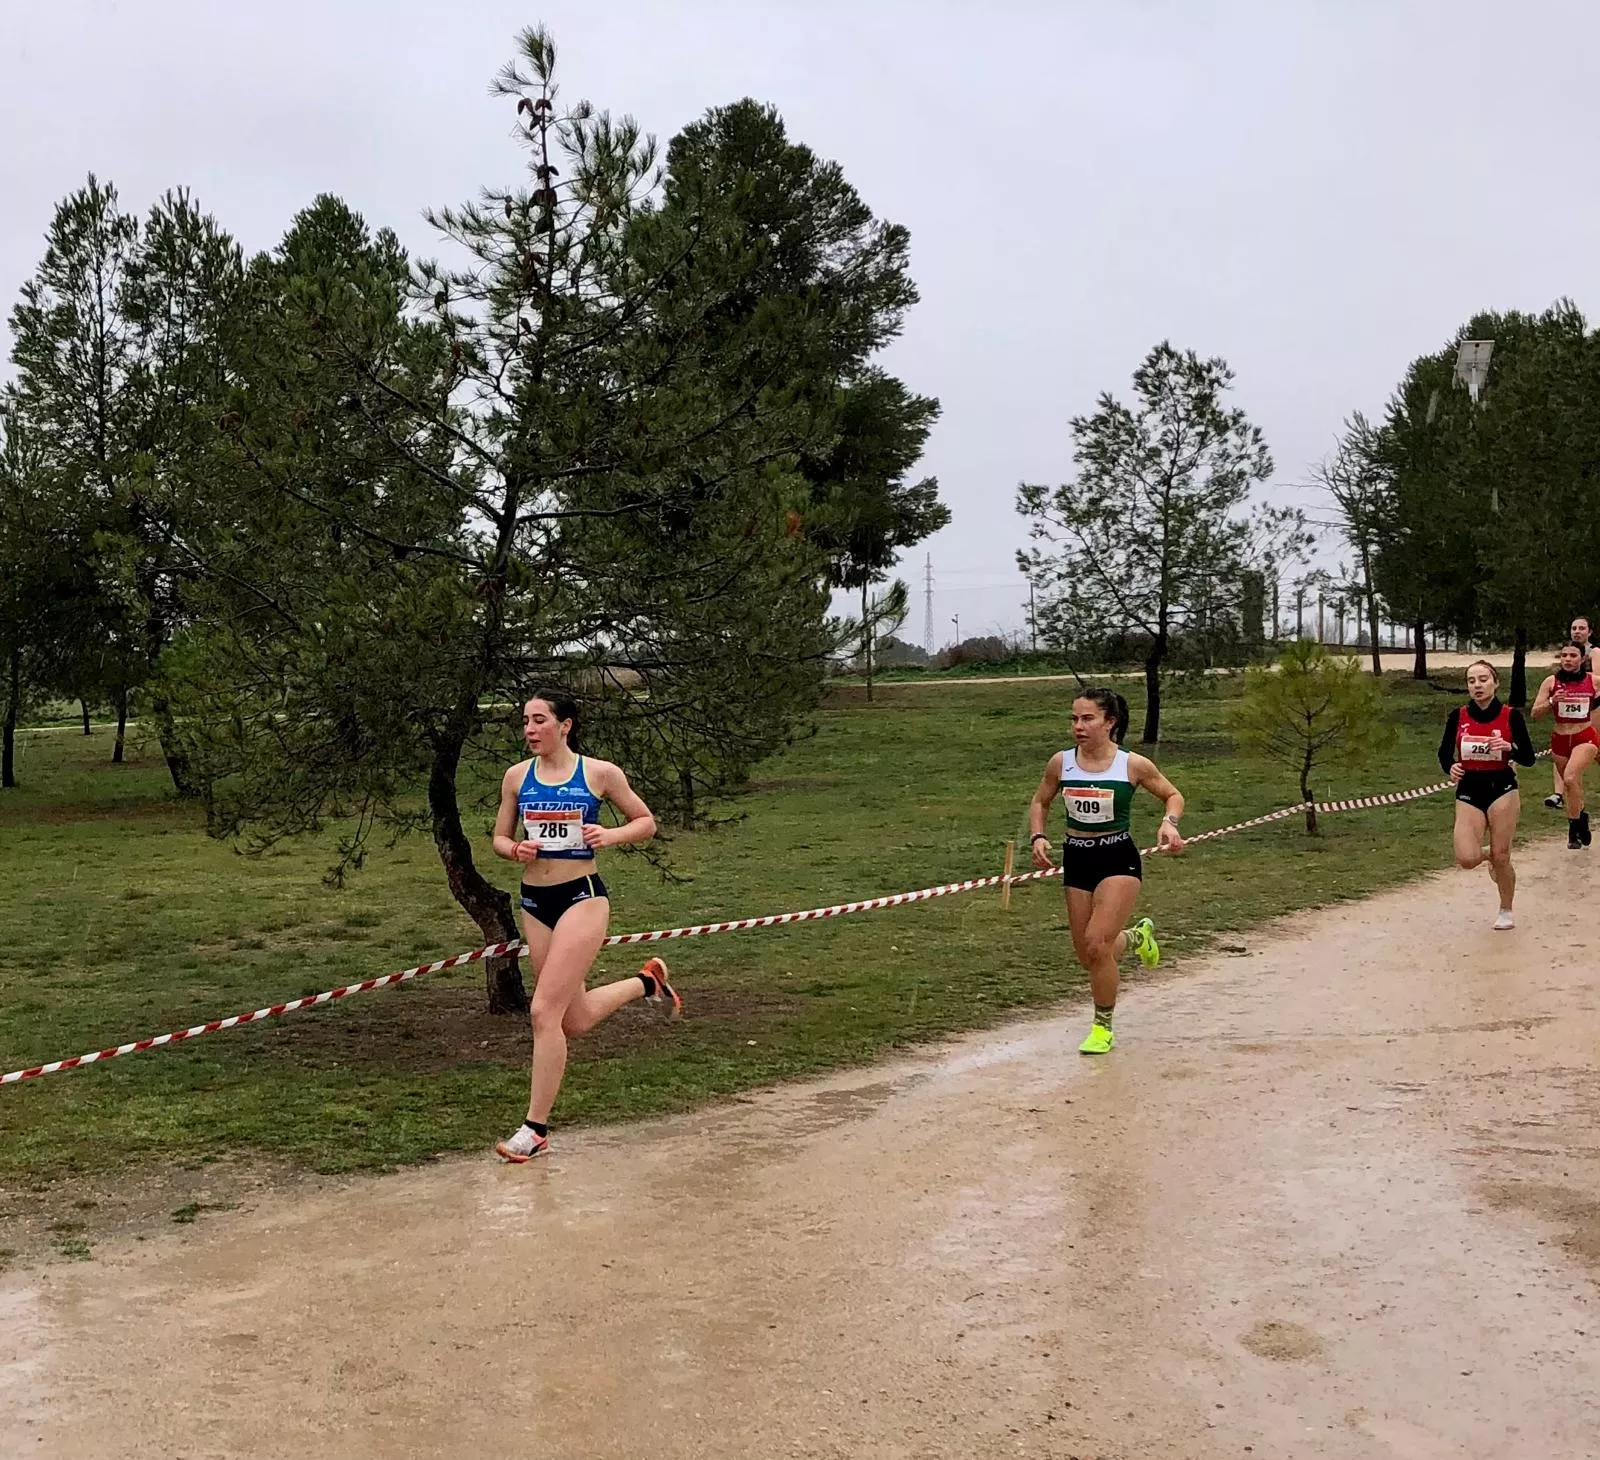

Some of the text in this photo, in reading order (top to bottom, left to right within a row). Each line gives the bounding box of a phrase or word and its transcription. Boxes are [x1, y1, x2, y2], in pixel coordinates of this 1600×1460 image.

[1565, 704, 1581, 712] 254
[1075, 800, 1100, 814] 209
[539, 822, 568, 838] 286
[1069, 832, 1128, 847] PRO NIKE
